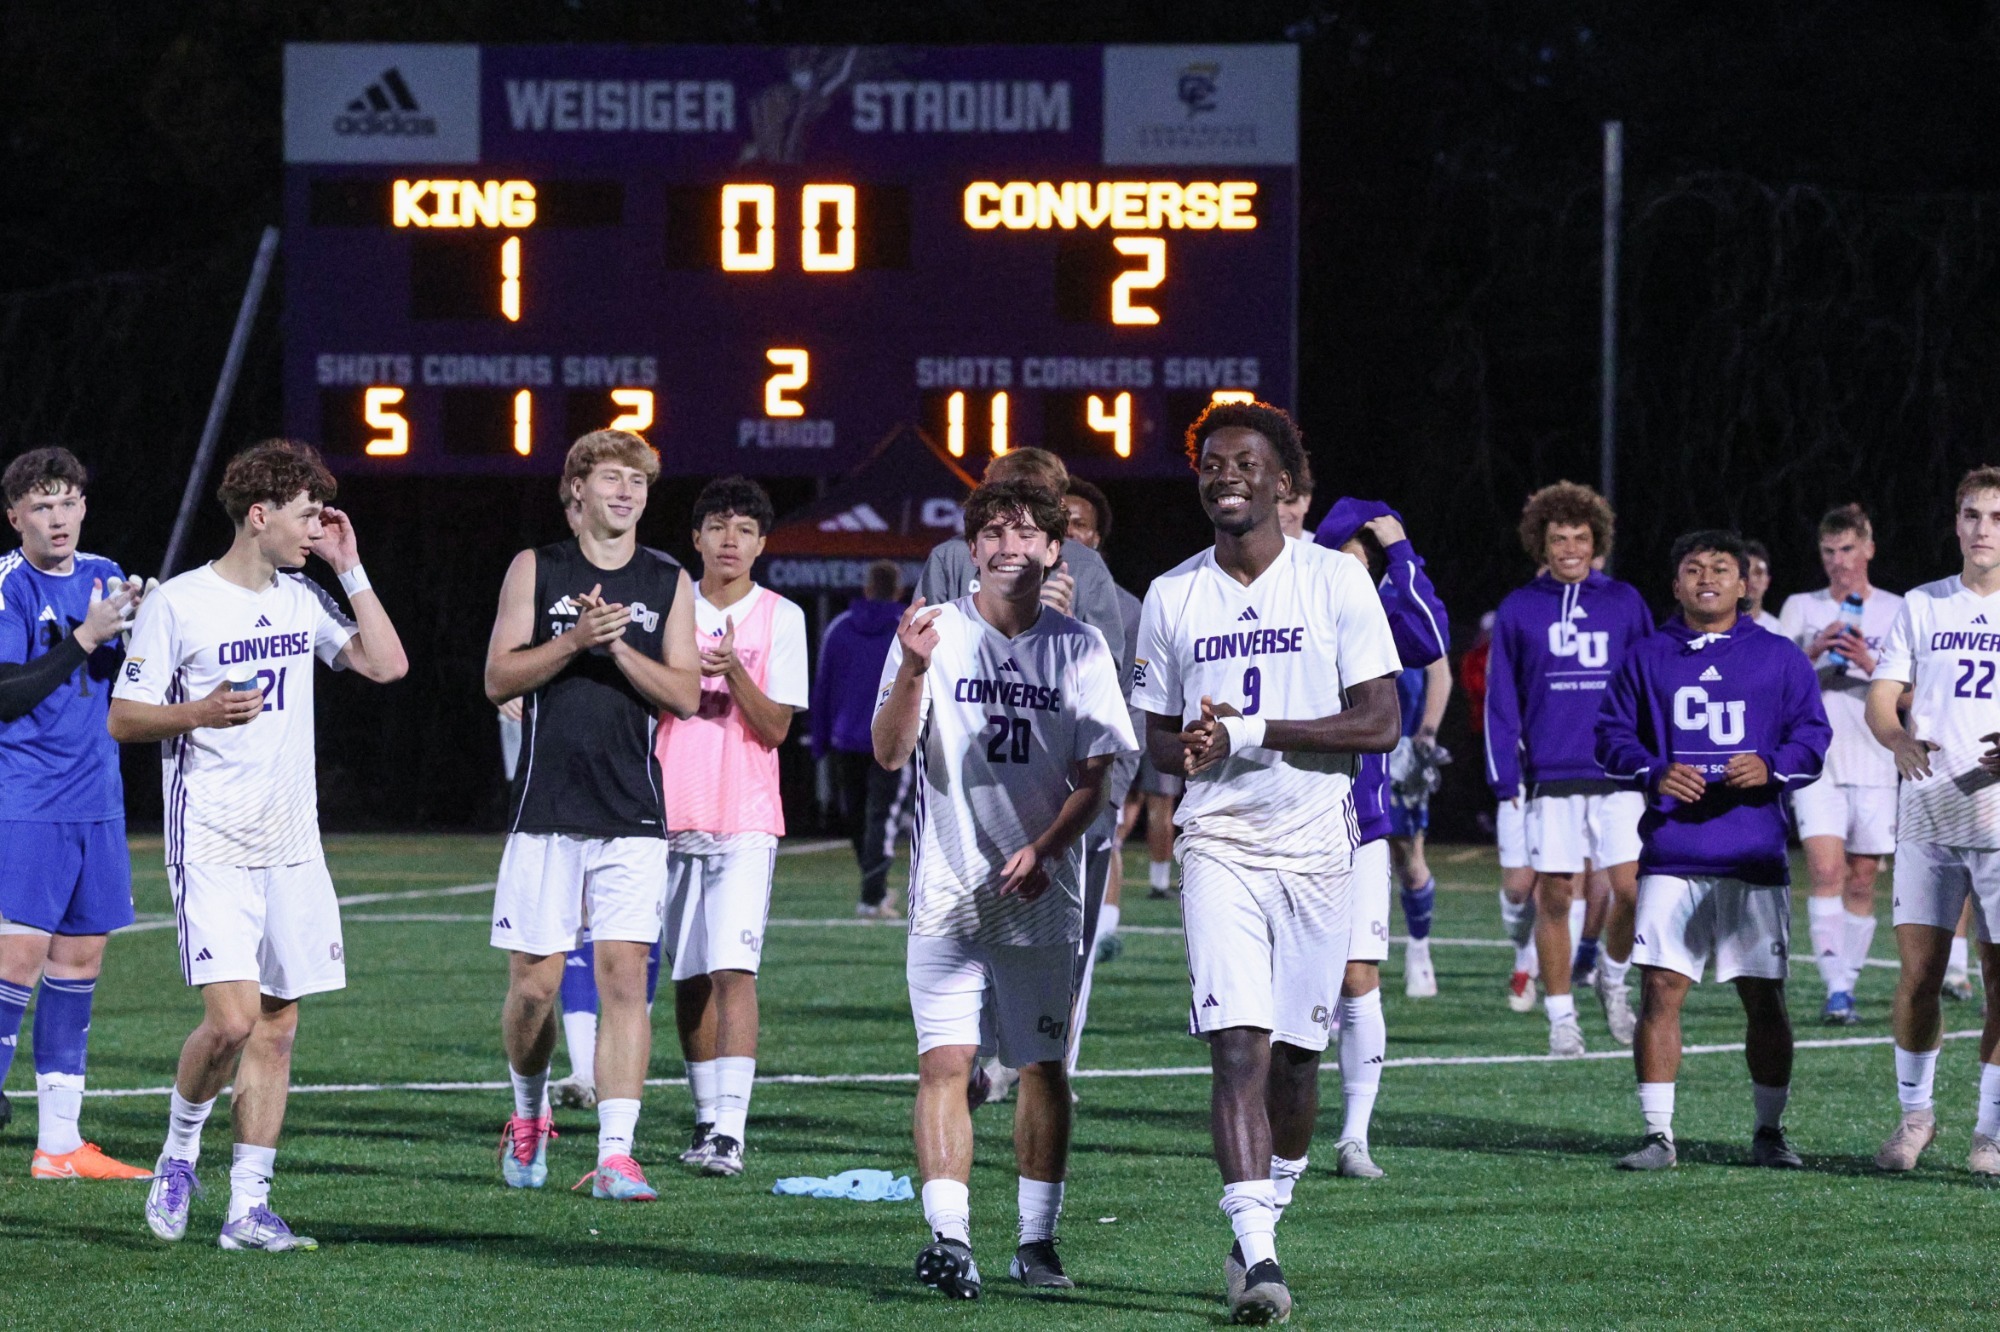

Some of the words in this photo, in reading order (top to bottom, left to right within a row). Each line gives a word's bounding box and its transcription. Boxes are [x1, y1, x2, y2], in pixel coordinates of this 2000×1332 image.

[334, 114, 437, 136] adidas
[505, 80, 737, 131] WEISIGER
[852, 80, 1072, 132] STADIUM
[393, 180, 536, 228] KING
[964, 181, 1258, 229] CONVERSE
[501, 236, 520, 322] 1
[1112, 237, 1166, 325] 2
[316, 354, 412, 385] SHOTS
[423, 355, 553, 386] CORNERS
[562, 356, 658, 387] SAVES
[766, 348, 809, 416] 2
[916, 357, 1011, 388] SHOTS
[1022, 357, 1154, 389] CORNERS
[1164, 358, 1260, 390] SAVES
[365, 387, 408, 455] 5
[514, 389, 531, 456] 1
[948, 391, 1008, 457] 11
[1087, 391, 1131, 458] 4
[630, 602, 659, 633] CU
[218, 631, 309, 666] CONVERSE
[1194, 627, 1304, 663] CONVERSE
[1548, 621, 1609, 668] CU
[256, 667, 287, 712] 21
[955, 678, 1060, 712] CONVERSE
[1243, 666, 1261, 715] 9
[1954, 658, 1996, 699] 22
[987, 715, 1031, 764] 20
[1674, 686, 1746, 746] CU
